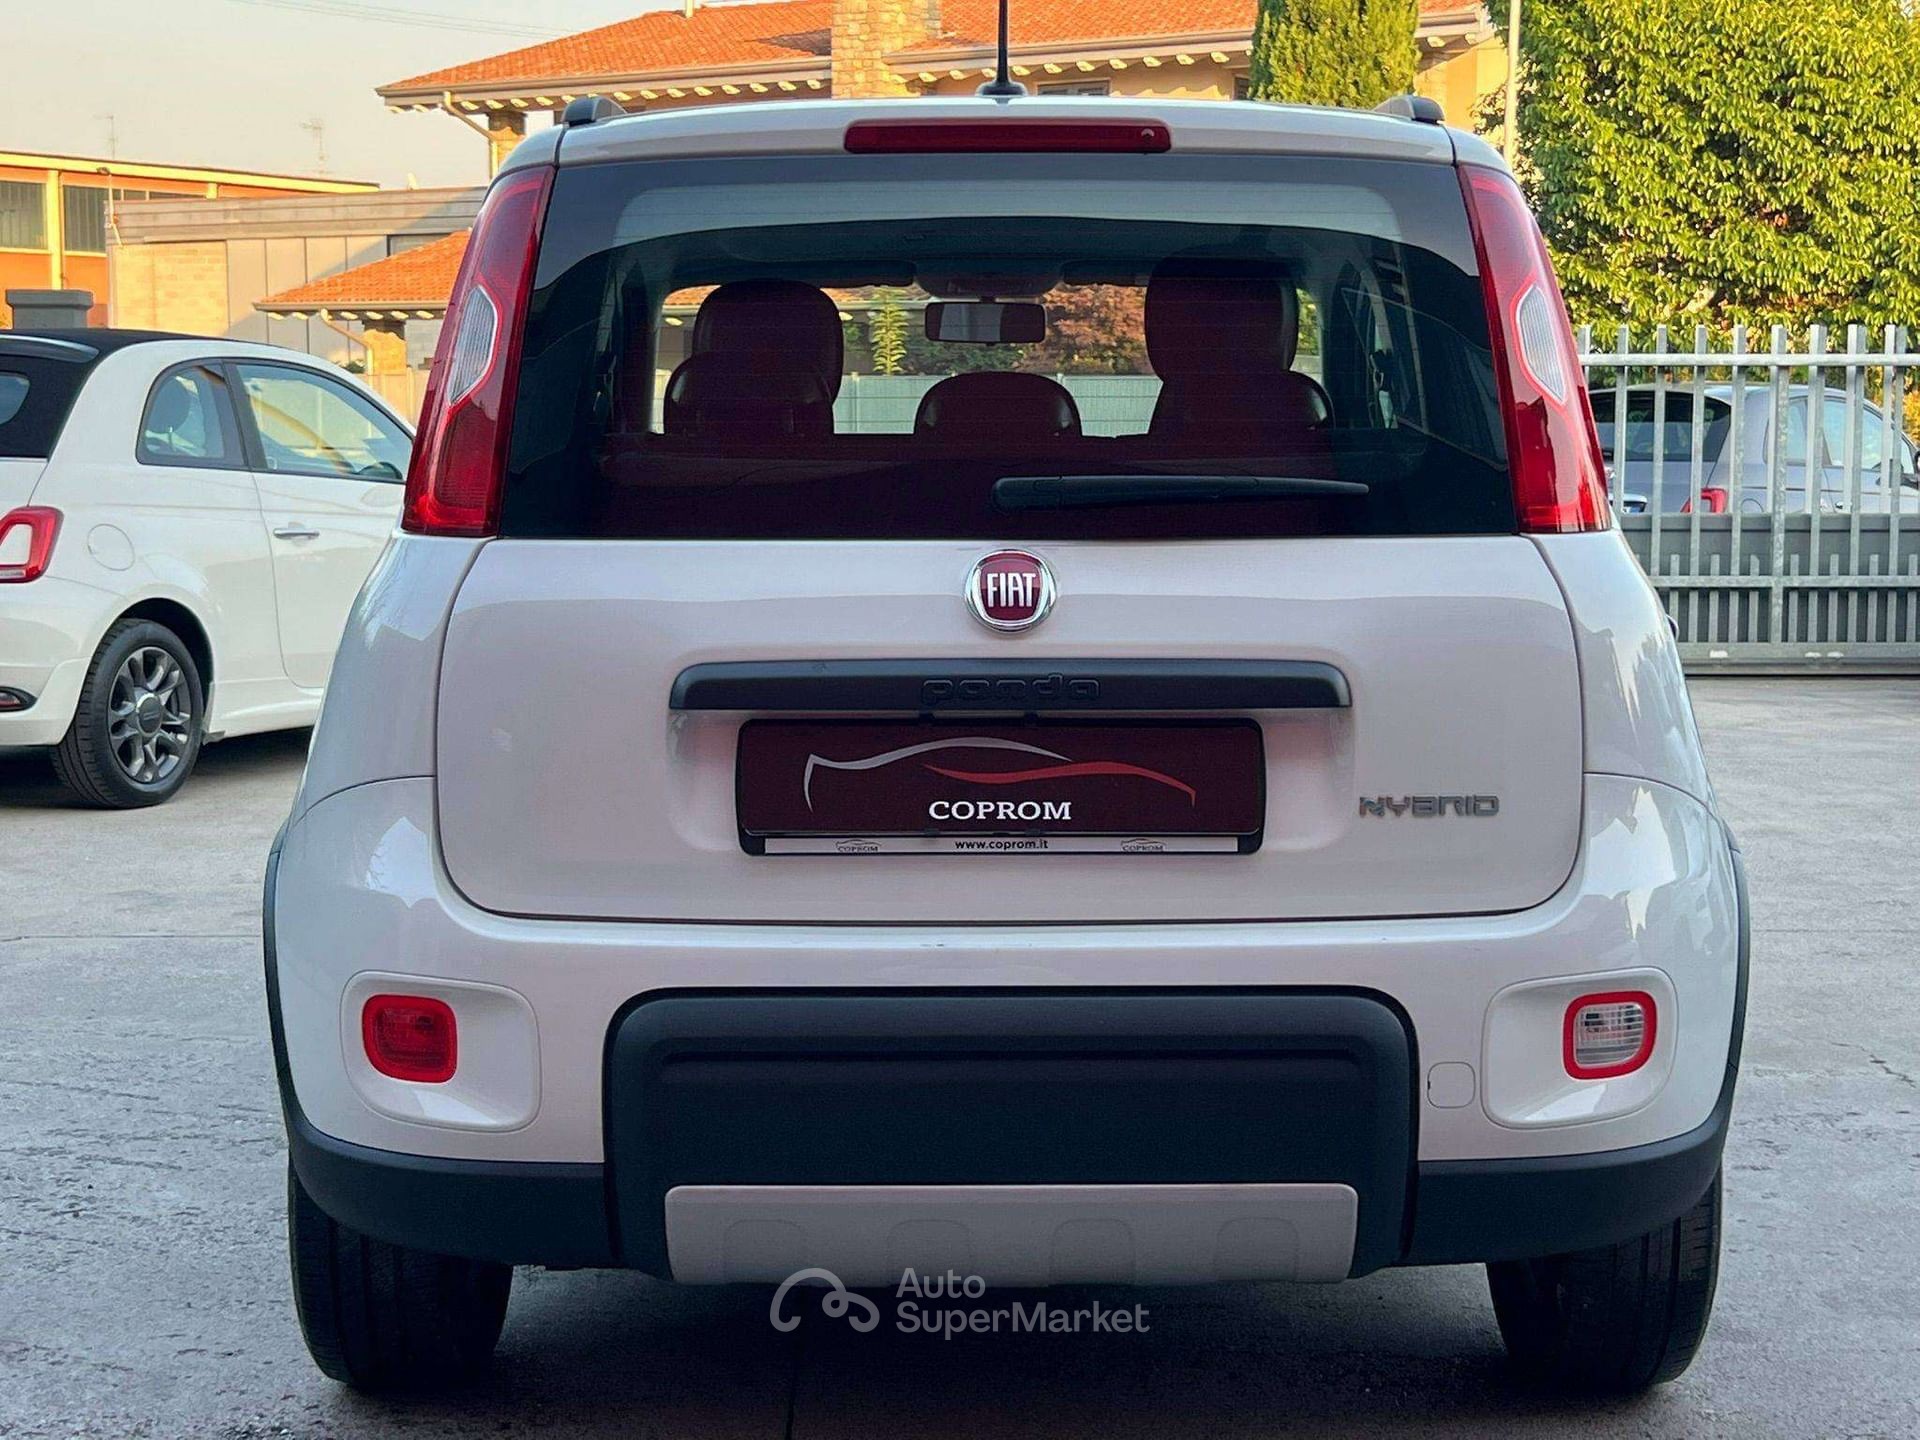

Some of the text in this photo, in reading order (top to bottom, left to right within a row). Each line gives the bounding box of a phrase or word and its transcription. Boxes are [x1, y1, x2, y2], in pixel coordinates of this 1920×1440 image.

[986, 572, 1036, 607] FIAT
[921, 673, 1099, 706] panda
[929, 801, 1072, 820] COPROM
[955, 839, 1048, 850] www.coprom.it
